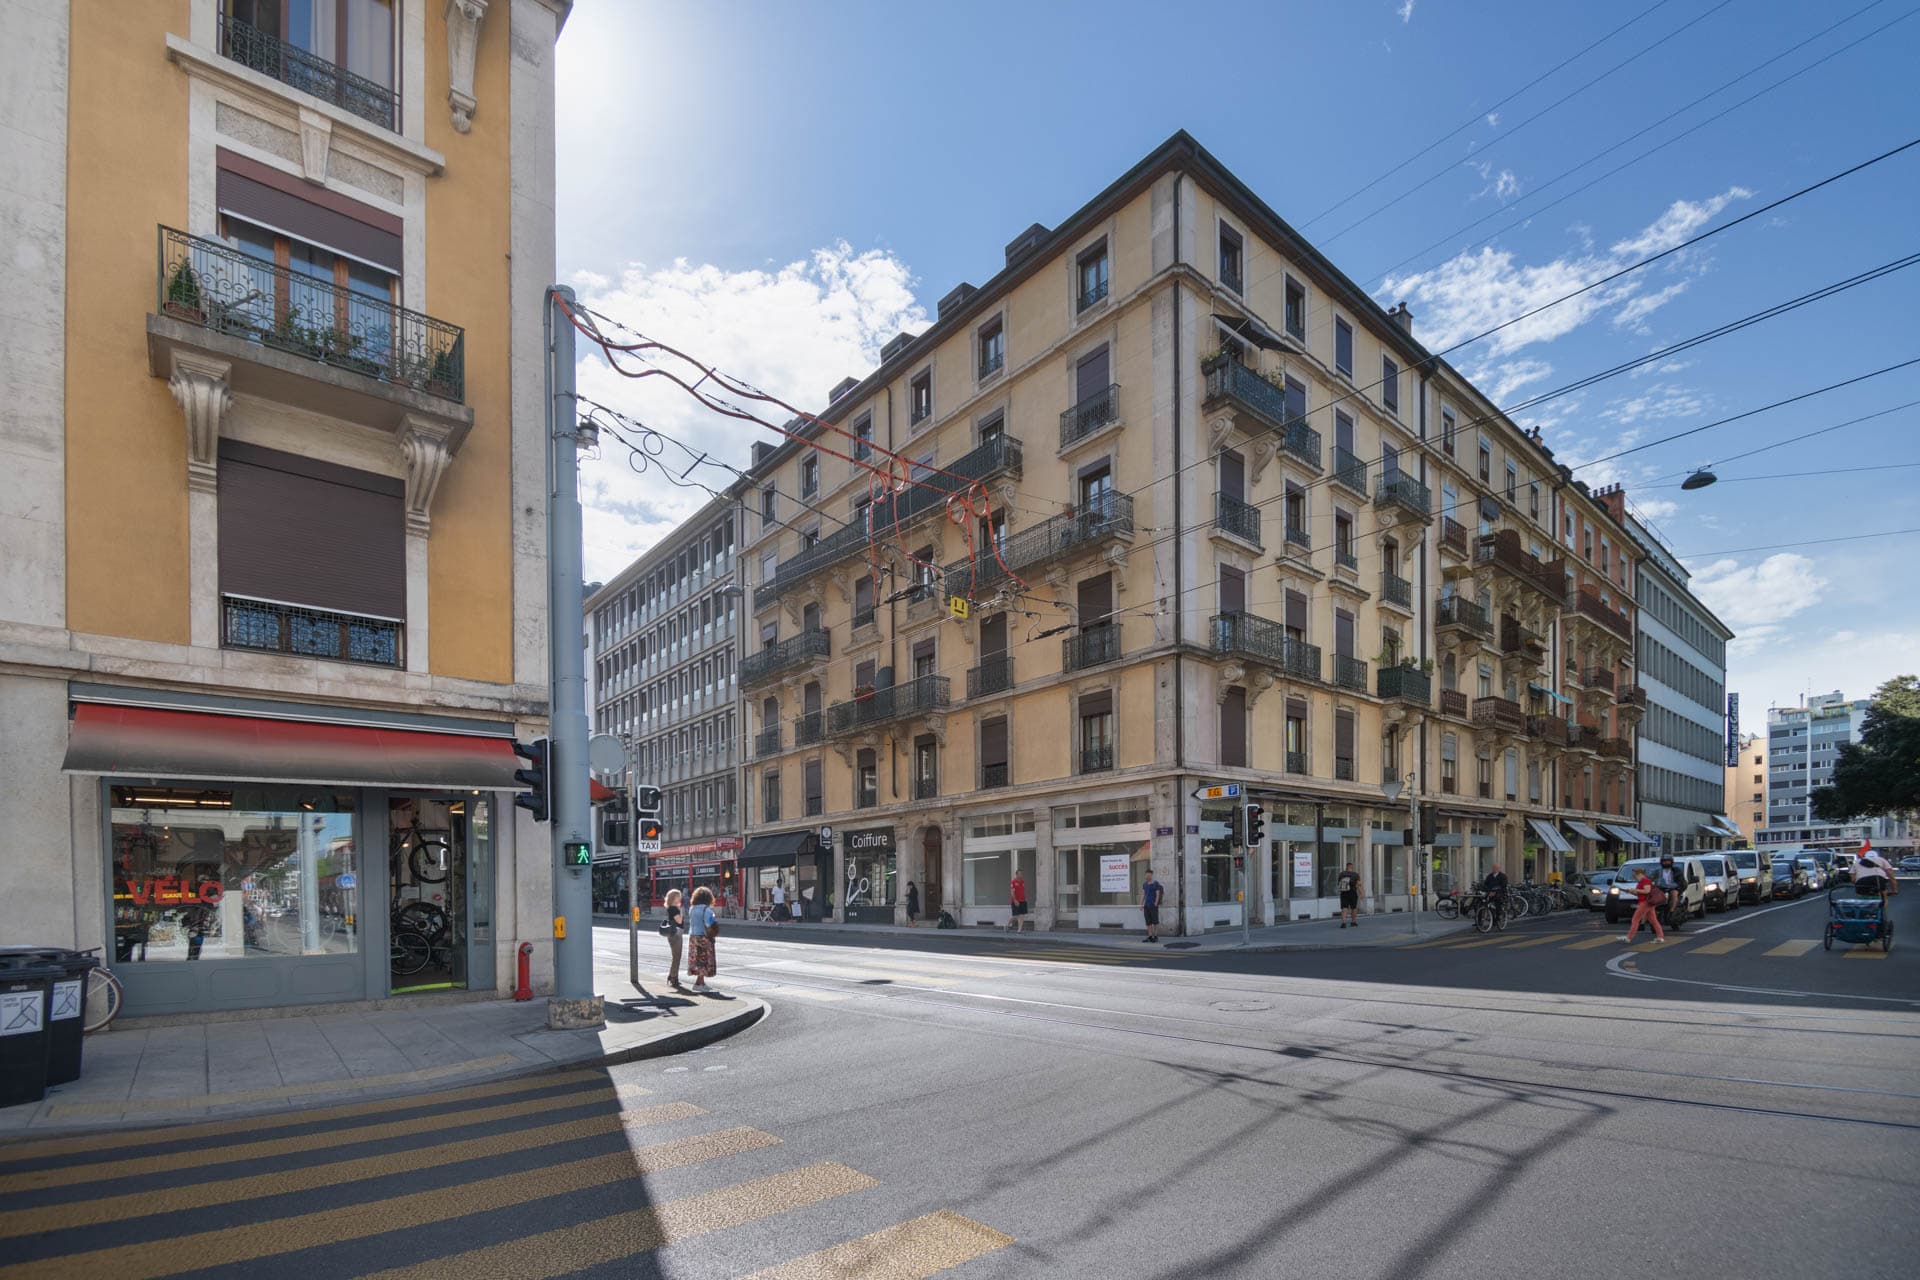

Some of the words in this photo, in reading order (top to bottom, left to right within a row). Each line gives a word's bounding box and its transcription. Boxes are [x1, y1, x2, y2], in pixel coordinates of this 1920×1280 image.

[641, 842, 659, 850] TAXI
[851, 833, 888, 848] Coiffure
[126, 875, 224, 905] VÉLO
